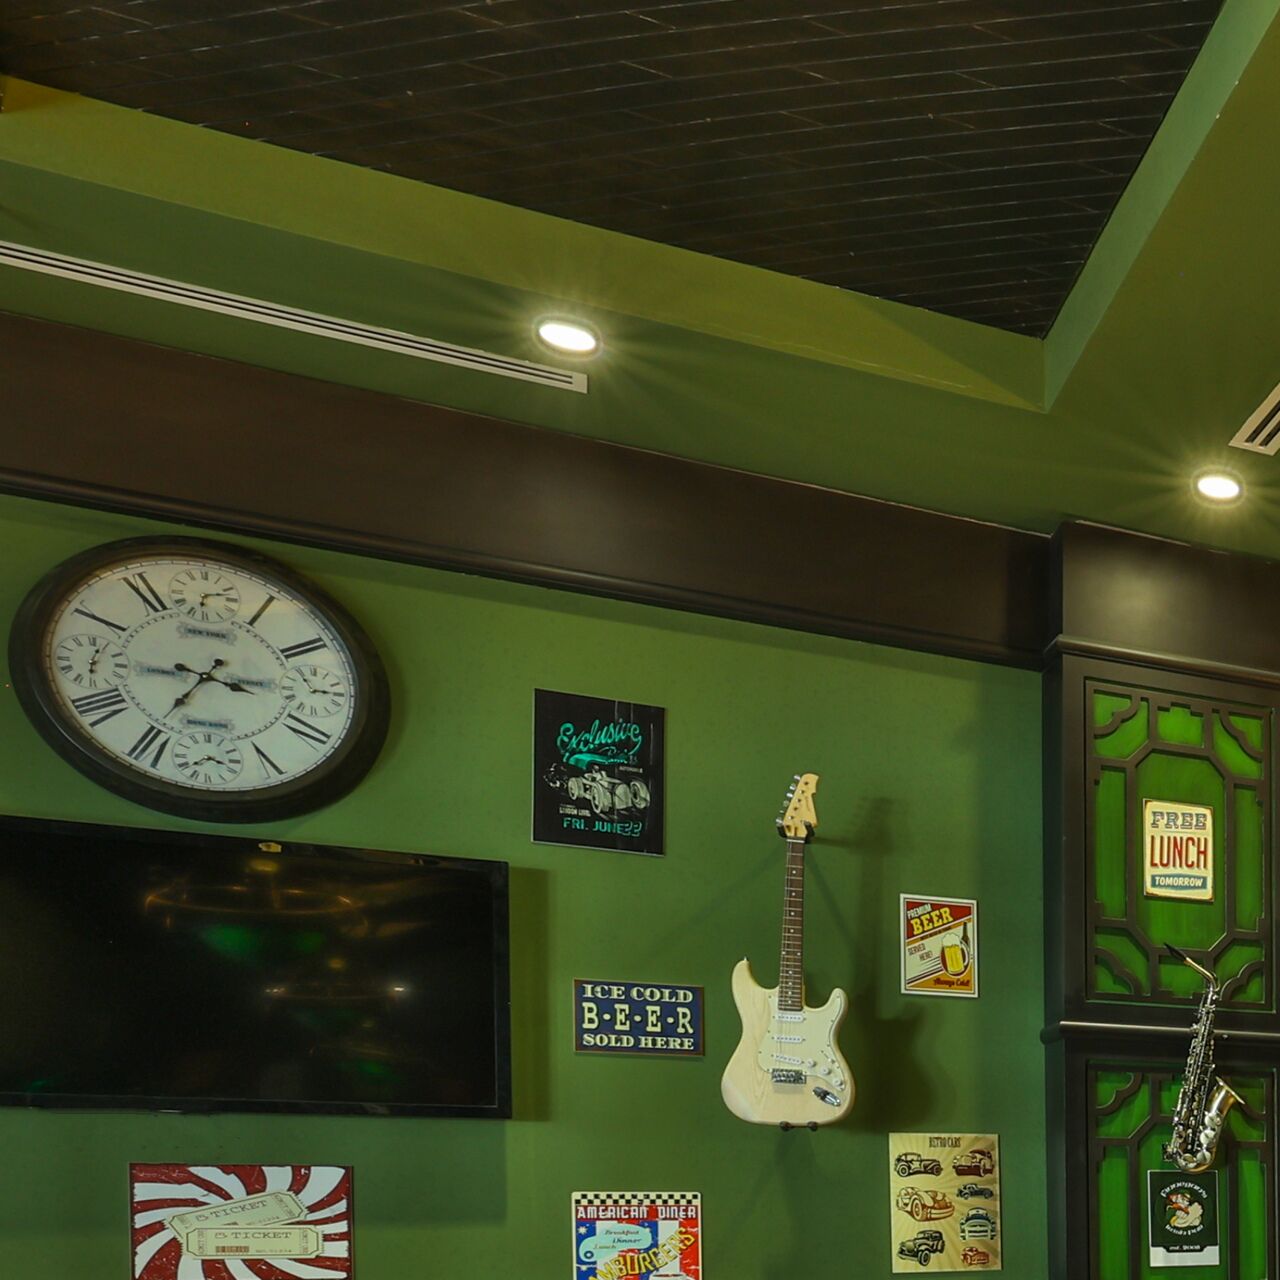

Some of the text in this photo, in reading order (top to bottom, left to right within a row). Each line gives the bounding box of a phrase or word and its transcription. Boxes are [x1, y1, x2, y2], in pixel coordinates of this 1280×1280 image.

[557, 717, 643, 756] Exclusive
[592, 818, 622, 834] JUNE
[1151, 811, 1208, 830] FREE
[1150, 835, 1209, 869] LUNCH
[1155, 876, 1204, 888] TOMORROW
[911, 912, 954, 935] BEER
[582, 984, 693, 1003] ICE COLD
[582, 1033, 694, 1050] SOLD HERE
[210, 1200, 268, 1219] TICKET
[577, 1206, 697, 1219] AMERICAN DINER
[231, 1232, 293, 1240] TICKET
